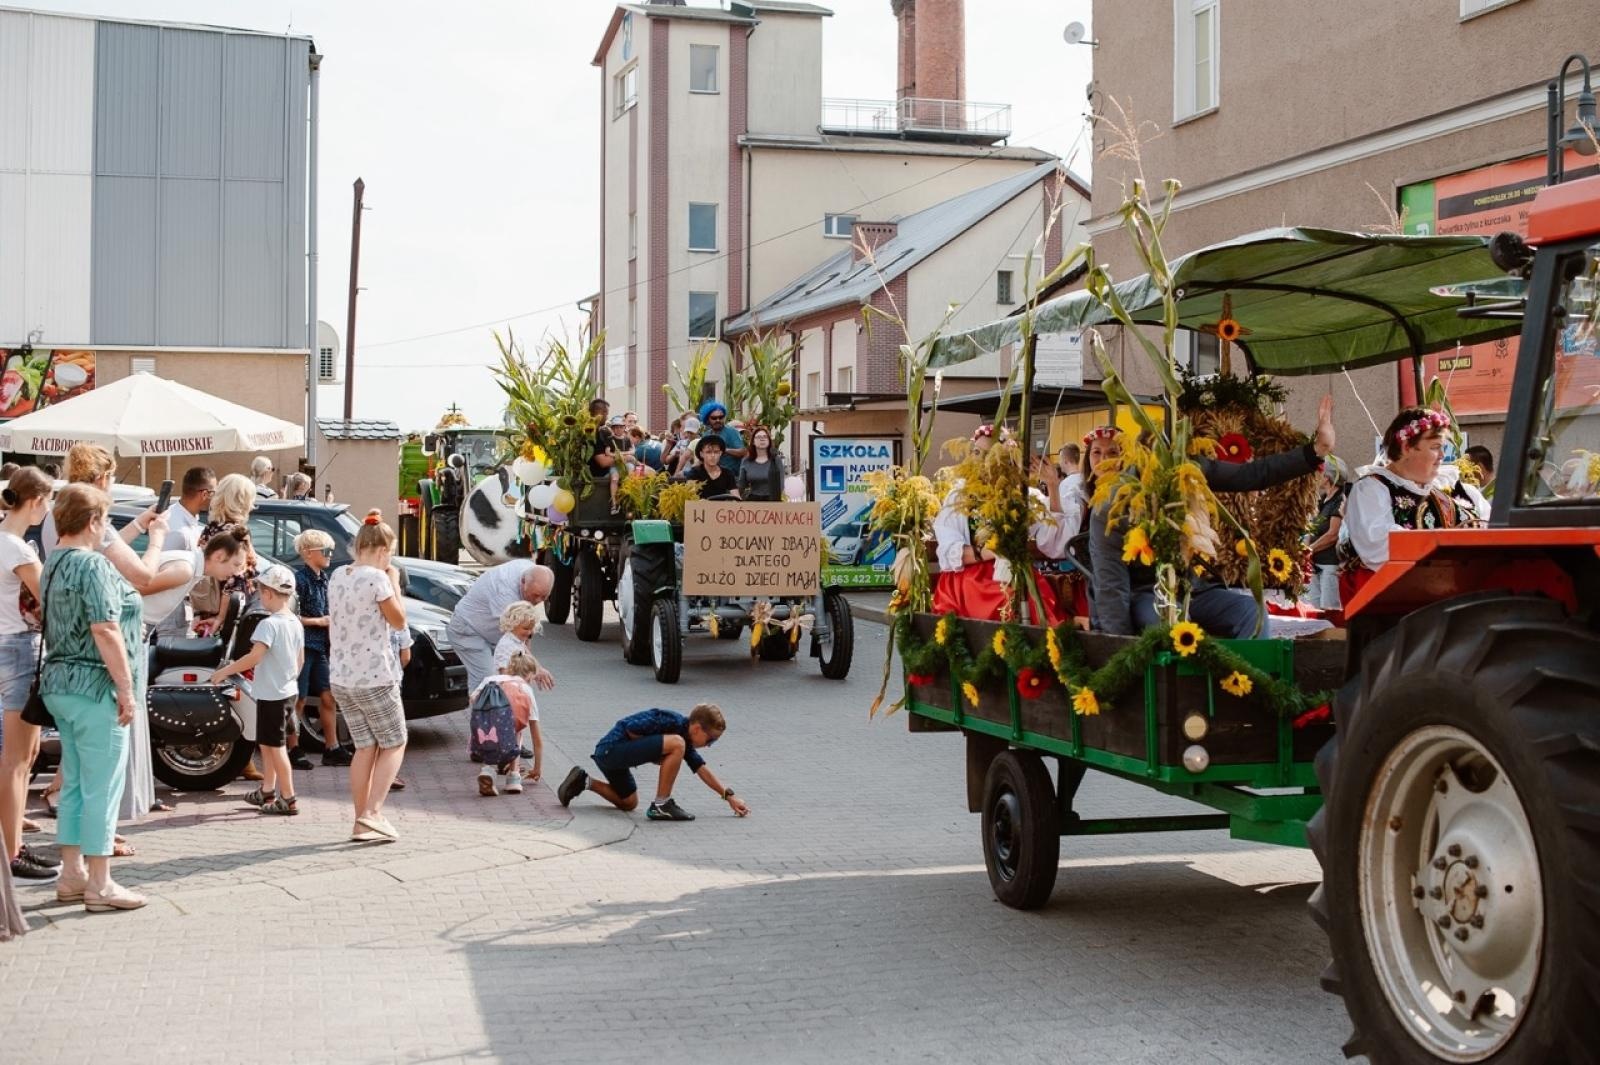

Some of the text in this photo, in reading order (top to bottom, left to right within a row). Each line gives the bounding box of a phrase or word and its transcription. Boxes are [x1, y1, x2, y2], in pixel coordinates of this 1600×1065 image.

[140, 436, 214, 453] RACIBORSKIE
[819, 444, 890, 458] SZKOŁA
[693, 509, 705, 523] W
[700, 535, 712, 552] O
[719, 536, 775, 551] BOCIANY
[735, 555, 791, 567] DLATEGO
[696, 571, 736, 585] DUŻO
[745, 572, 780, 586] DZIECI
[852, 574, 871, 583] 422
